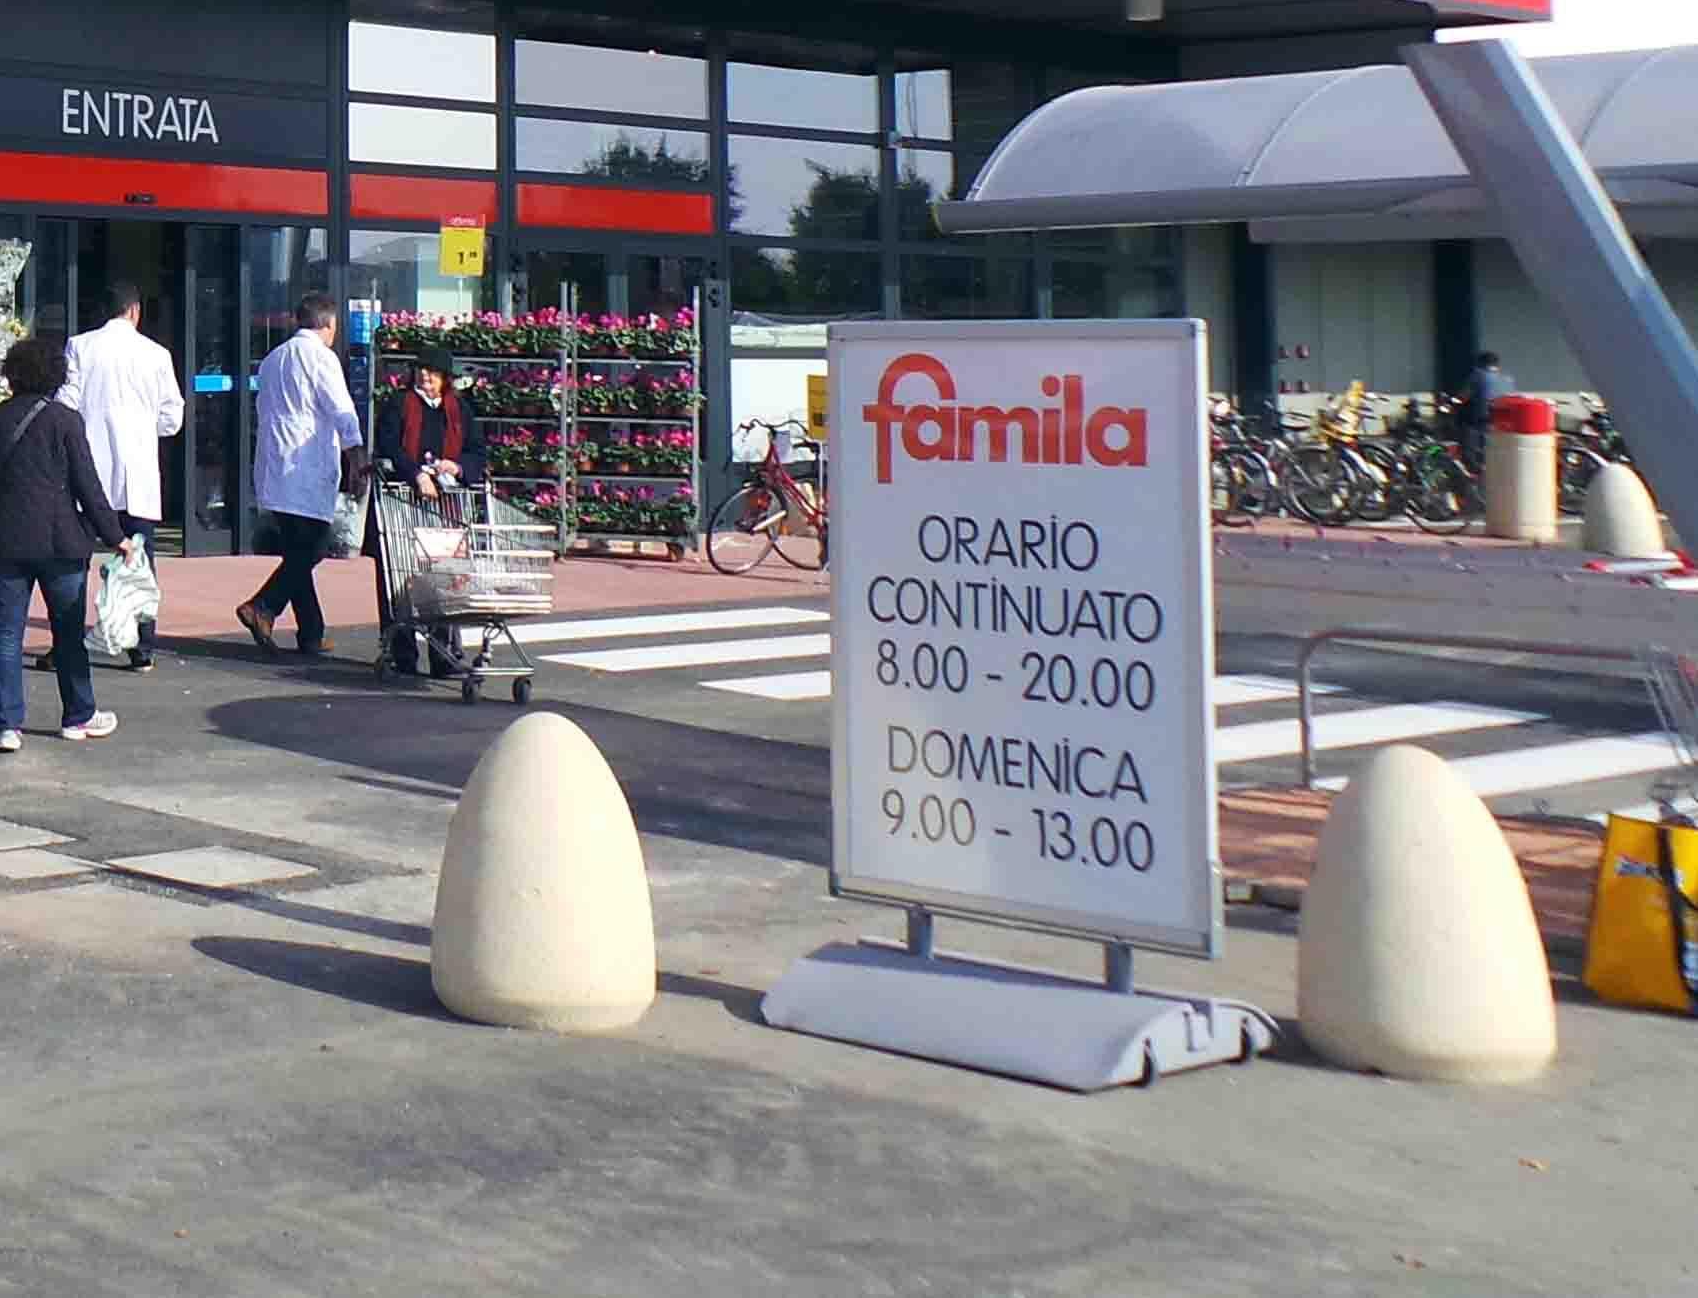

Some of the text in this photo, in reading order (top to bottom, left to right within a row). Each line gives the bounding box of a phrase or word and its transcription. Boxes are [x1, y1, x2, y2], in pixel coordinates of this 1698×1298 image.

[62, 88, 219, 143] ENTRATA
[862, 353, 1147, 484] famila
[876, 638, 969, 693] 8.00
[1021, 651, 1155, 711] 20.00
[881, 788, 976, 846] 9.00
[1031, 807, 1154, 872] 13.00
